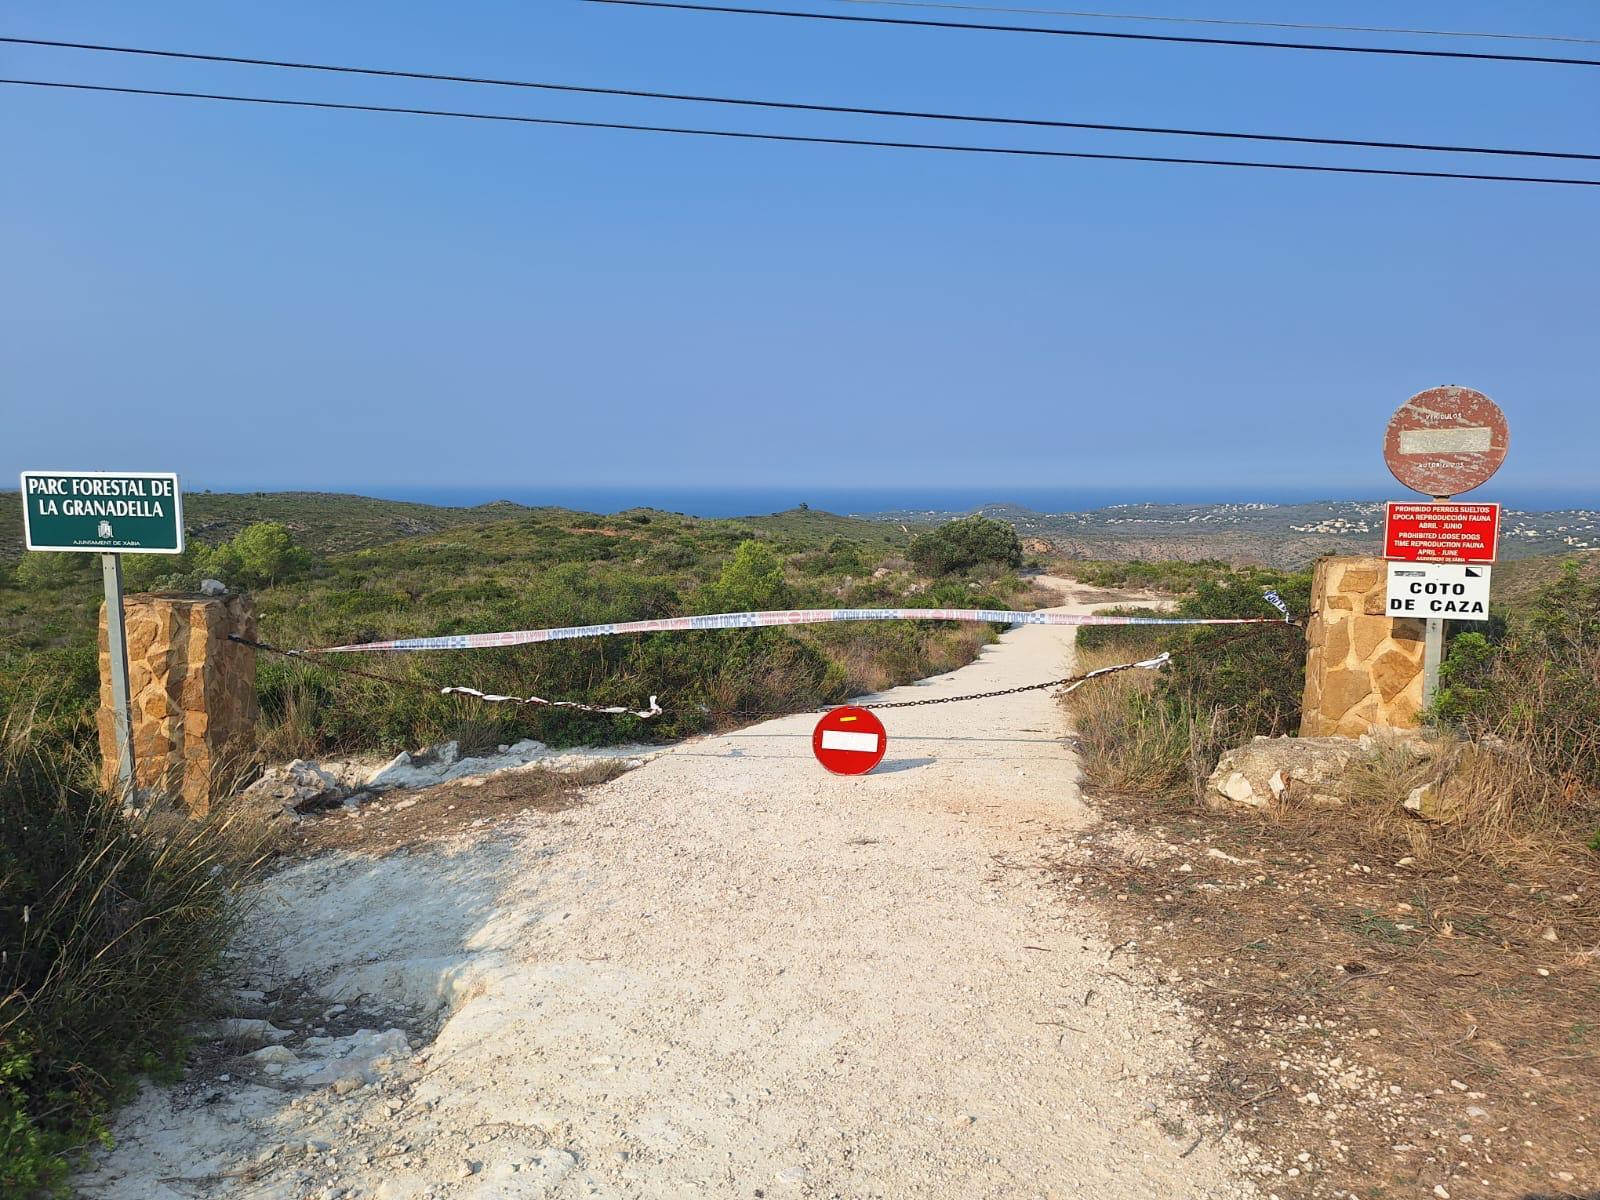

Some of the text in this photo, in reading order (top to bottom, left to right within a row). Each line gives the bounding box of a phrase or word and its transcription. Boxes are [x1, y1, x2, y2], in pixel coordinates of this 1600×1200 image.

[28, 478, 172, 497] PARC FORESTAL DE
[39, 499, 164, 518] LA GRANADELLA
[1410, 582, 1465, 595] COTO
[1390, 598, 1484, 613] DE CAZA
